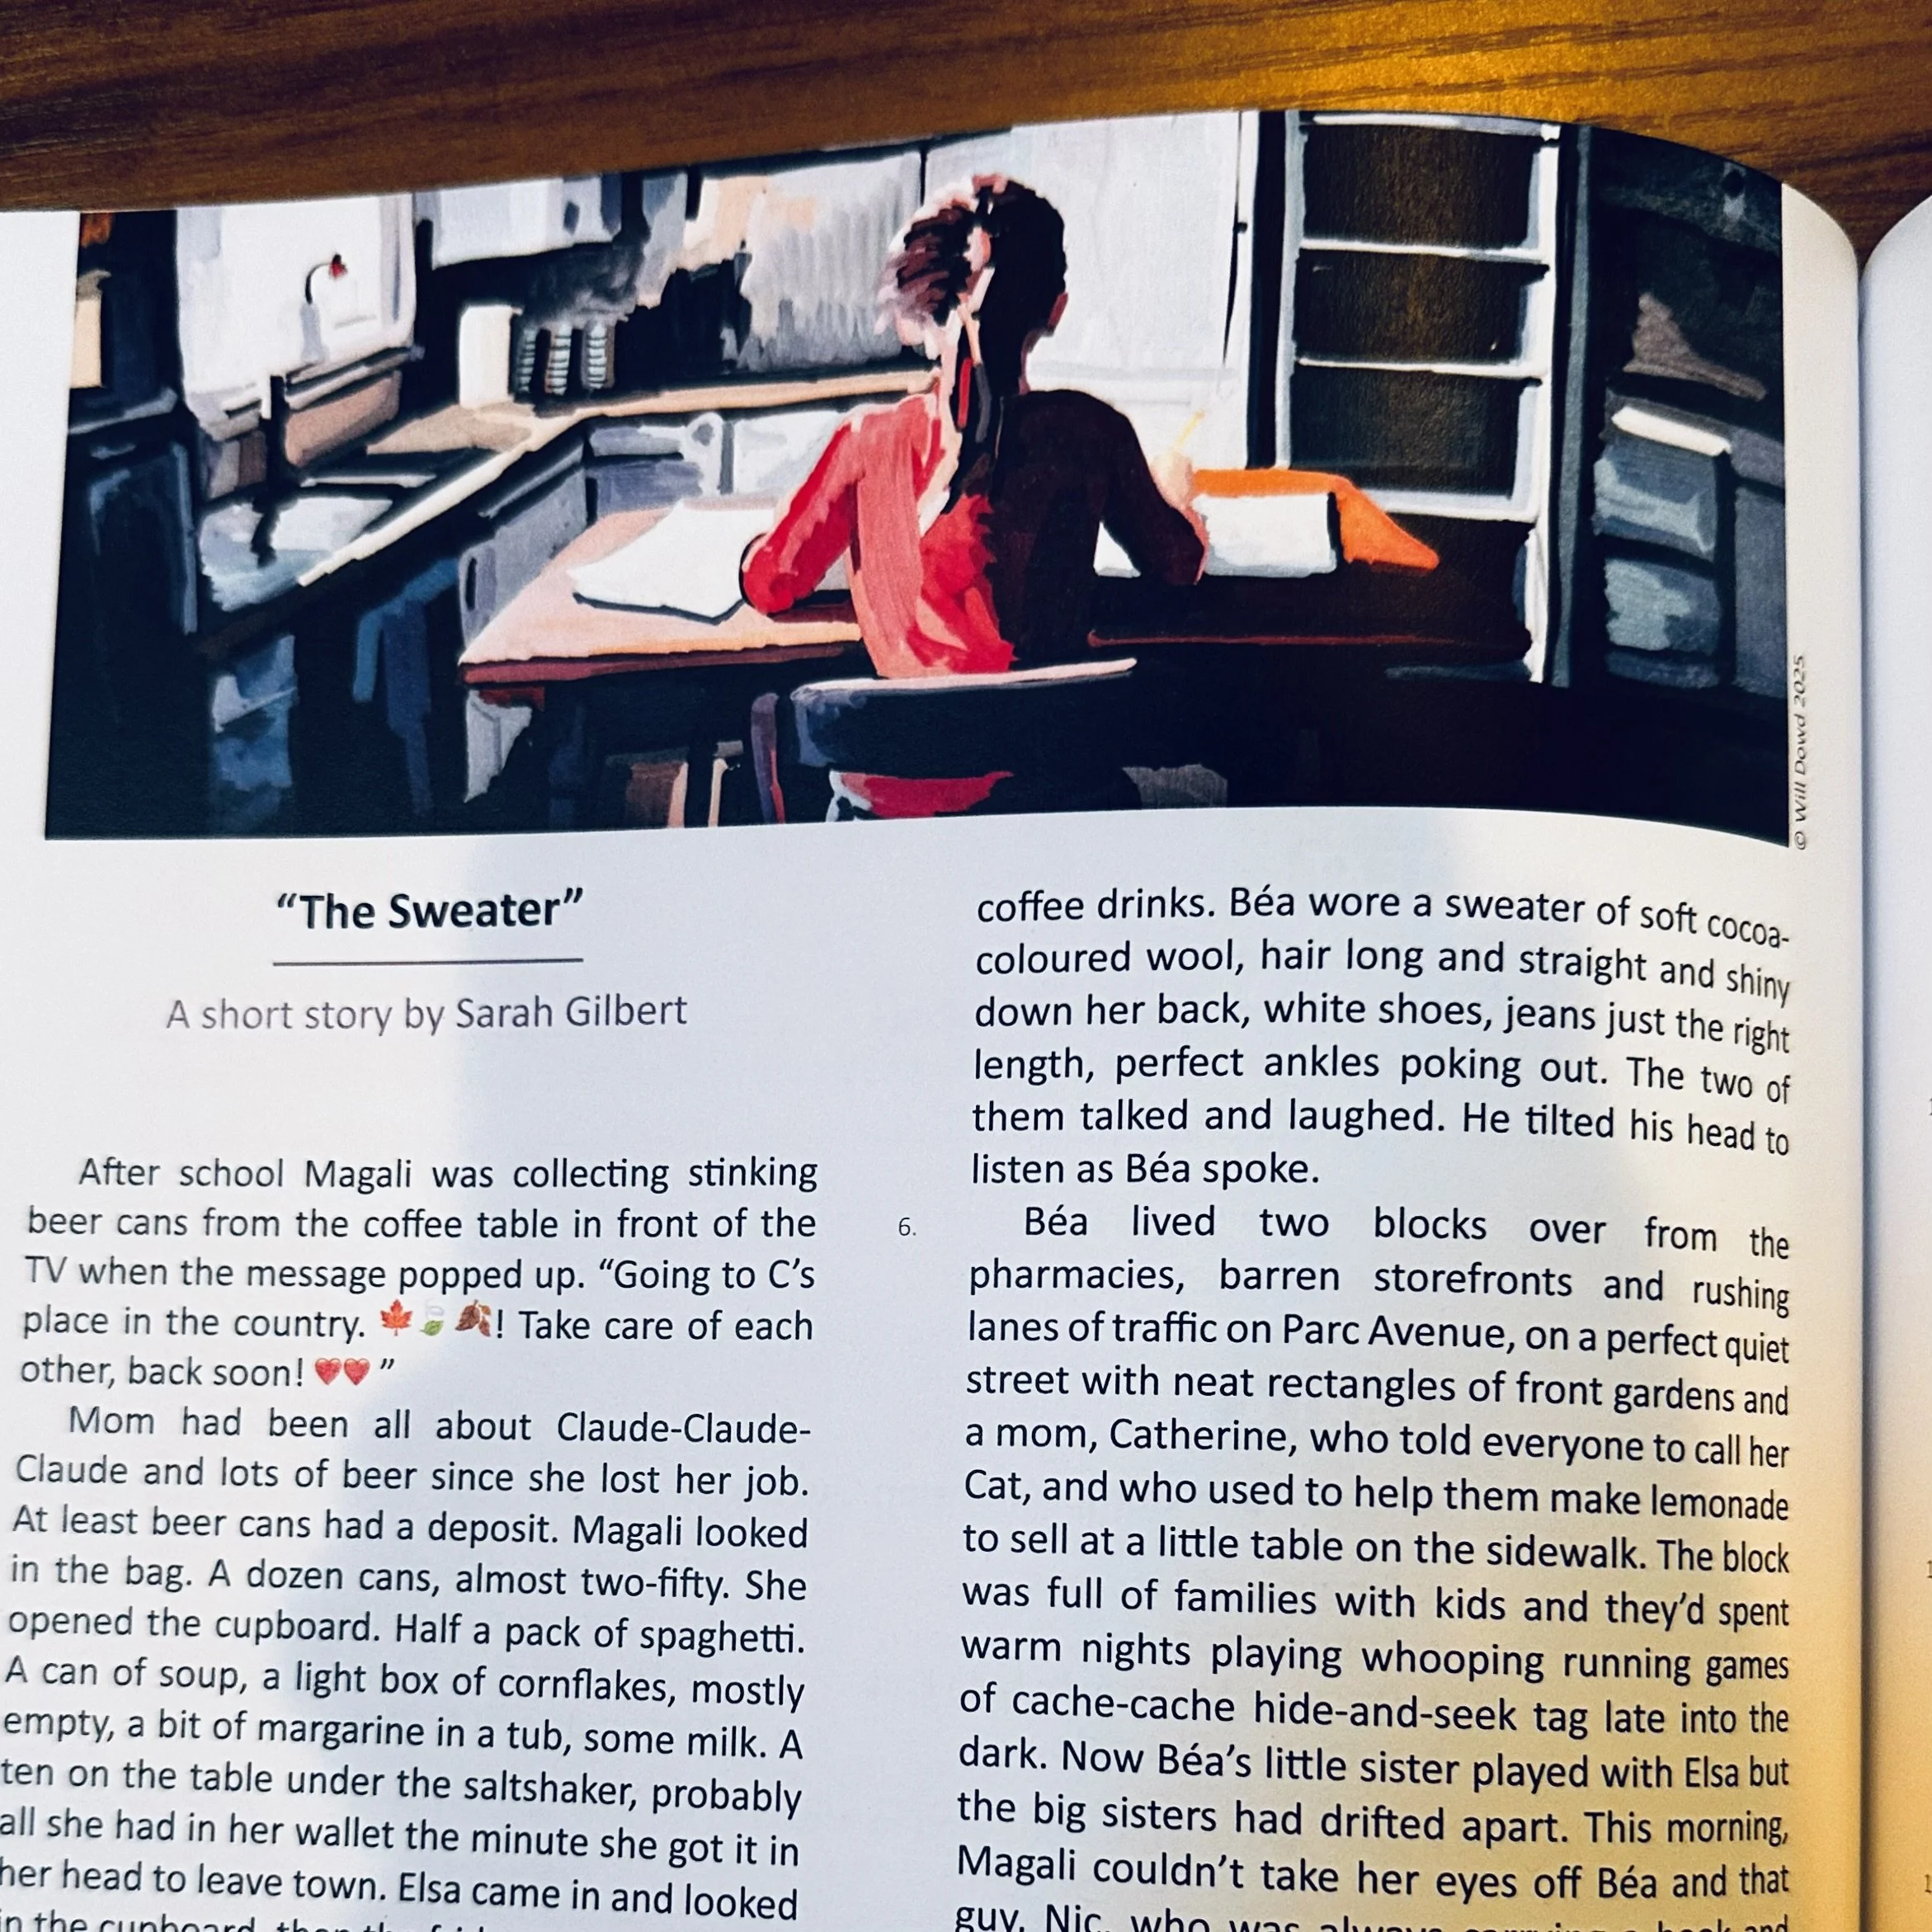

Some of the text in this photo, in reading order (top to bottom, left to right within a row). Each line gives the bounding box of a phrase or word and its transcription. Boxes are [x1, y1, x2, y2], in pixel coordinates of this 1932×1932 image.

[1793, 654, 1806, 708] 2025
[1793, 714, 1807, 775] Dowd
[1795, 781, 1807, 822] Will
[276, 887, 584, 930] “The Sweater”
[977, 884, 1790, 950] coffee drinks. Béa wore a sweater of soft cocoa-
[166, 992, 688, 1037] A short story by Sarah Gilbert
[975, 990, 1791, 1056] down her back, white shoes, jeans just the right
[78, 1155, 818, 1195] After school Magali was collecting stinking
[973, 1150, 1319, 1191] listen as Béa spoke.
[898, 1217, 917, 1236] 6.
[1025, 1204, 1790, 1261] Béa lived two blocks over from the
[24, 1255, 815, 1297] TV when the message popped up. “Going to C’s
[970, 1256, 1791, 1319] pharmacies, barren storefronts and rushing
[20, 1353, 115, 1390] other,
[128, 1355, 203, 1386] back
[212, 1357, 304, 1388] soon!
[966, 1363, 1789, 1416] street with neat rectangles of front gardens and
[69, 1405, 812, 1444] Mom had been all about Claude-Claude-
[964, 1468, 1789, 1521] Cat, and who used to help them make lemonade
[12, 1503, 808, 1553] At least beer cans had a deposit. Magali looked
[962, 1575, 1790, 1634] was full of families with kids and they’d spent
[8, 1605, 804, 1659] opened the cupboard. Half a pack of spaghetti.
[960, 1631, 1789, 1688] warm nights playing whooping running games
[0, 1758, 803, 1821] ten on the table under the saltshaker, probably
[959, 1734, 1790, 1796] dark. Now Béa’s little sister played with Elsa but
[0, 1855, 798, 1921] her head to leave town. Elsa came in and looked
